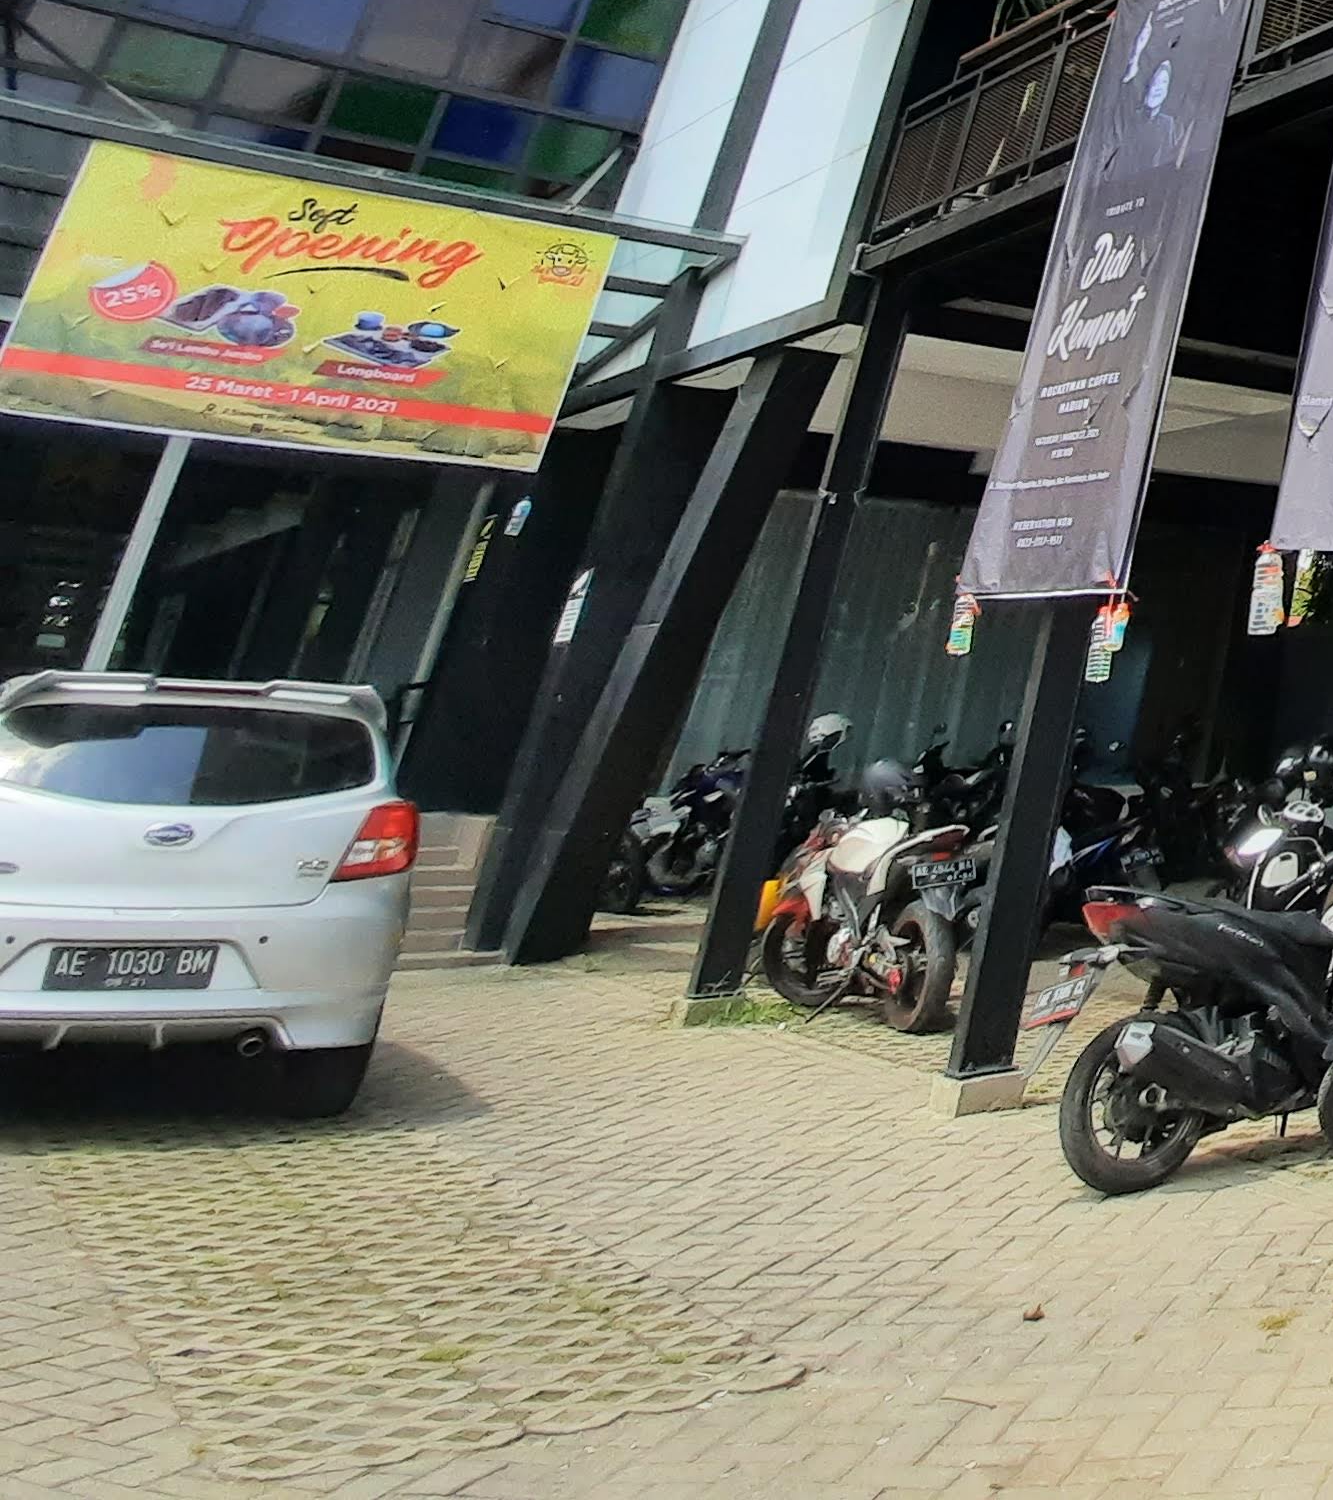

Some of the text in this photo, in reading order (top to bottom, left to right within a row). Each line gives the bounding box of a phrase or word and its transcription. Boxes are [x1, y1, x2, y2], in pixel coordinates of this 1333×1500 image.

[287, 198, 357, 233] Soft
[218, 215, 483, 289] Opening
[1079, 232, 1135, 290] Didi
[103, 281, 162, 309] 25%
[1046, 284, 1148, 362] Kempot
[336, 364, 415, 385] Longboard
[184, 375, 212, 391] 25
[216, 380, 272, 399] Maret
[290, 388, 299, 403] 1
[301, 390, 351, 409] April
[351, 396, 398, 414] 2021
[53, 949, 212, 977] AE 1030 BM
